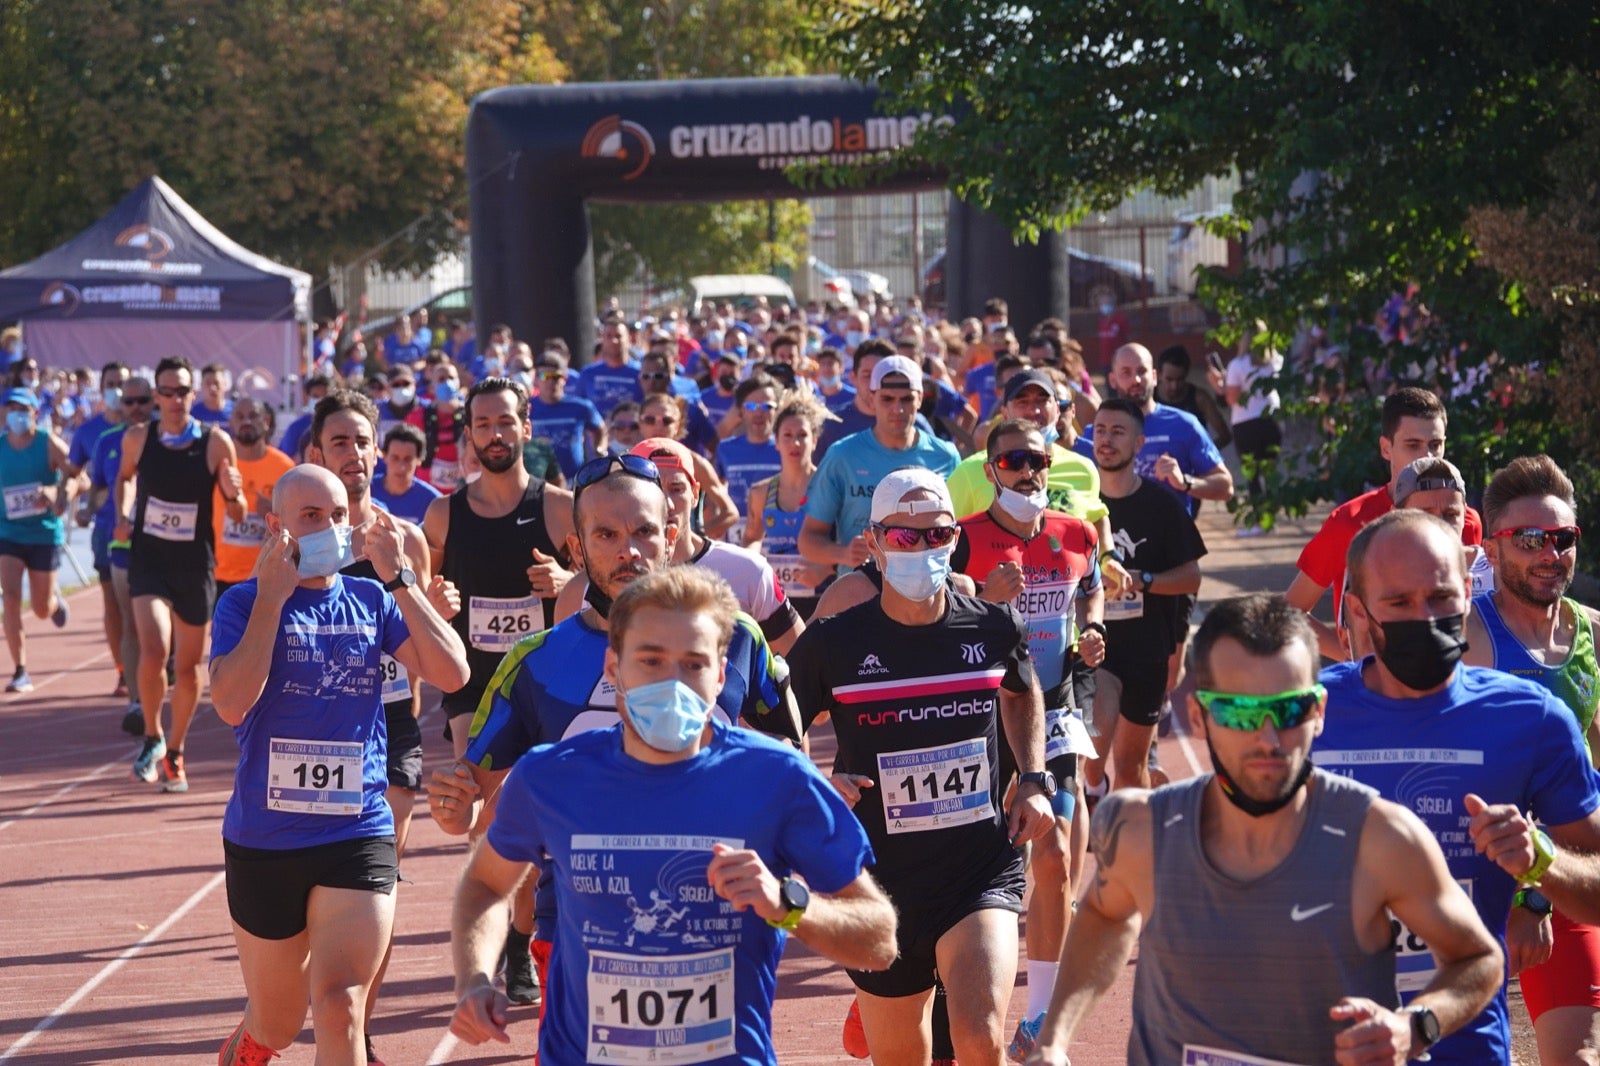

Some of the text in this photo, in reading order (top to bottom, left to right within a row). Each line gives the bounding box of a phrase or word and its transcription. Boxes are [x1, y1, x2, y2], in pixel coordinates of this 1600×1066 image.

[161, 513, 181, 528] 20
[231, 521, 266, 536] 105
[488, 614, 530, 634] 426
[287, 650, 308, 662] ESTELA
[1341, 752, 1348, 761] VI
[1384, 751, 1399, 761] AZUL
[1403, 751, 1415, 760] POR
[1430, 751, 1458, 761] AUTISMO
[293, 762, 344, 790] 191
[900, 763, 982, 802] 1147
[933, 798, 963, 814] JUANFRAN
[602, 838, 608, 847] VI
[612, 838, 642, 848] CARRERA
[645, 839, 661, 848] AZUL
[665, 838, 677, 848] POR
[680, 839, 688, 848] EL
[570, 854, 614, 871] VUELVE LA
[573, 876, 632, 895] ESTELA AZUL
[679, 884, 714, 903] SÍGUELA
[598, 957, 725, 974] VI CARRERA AZUL POR EL AUTISMO
[611, 984, 717, 1026] 1071
[656, 1029, 686, 1047] ALVARO
